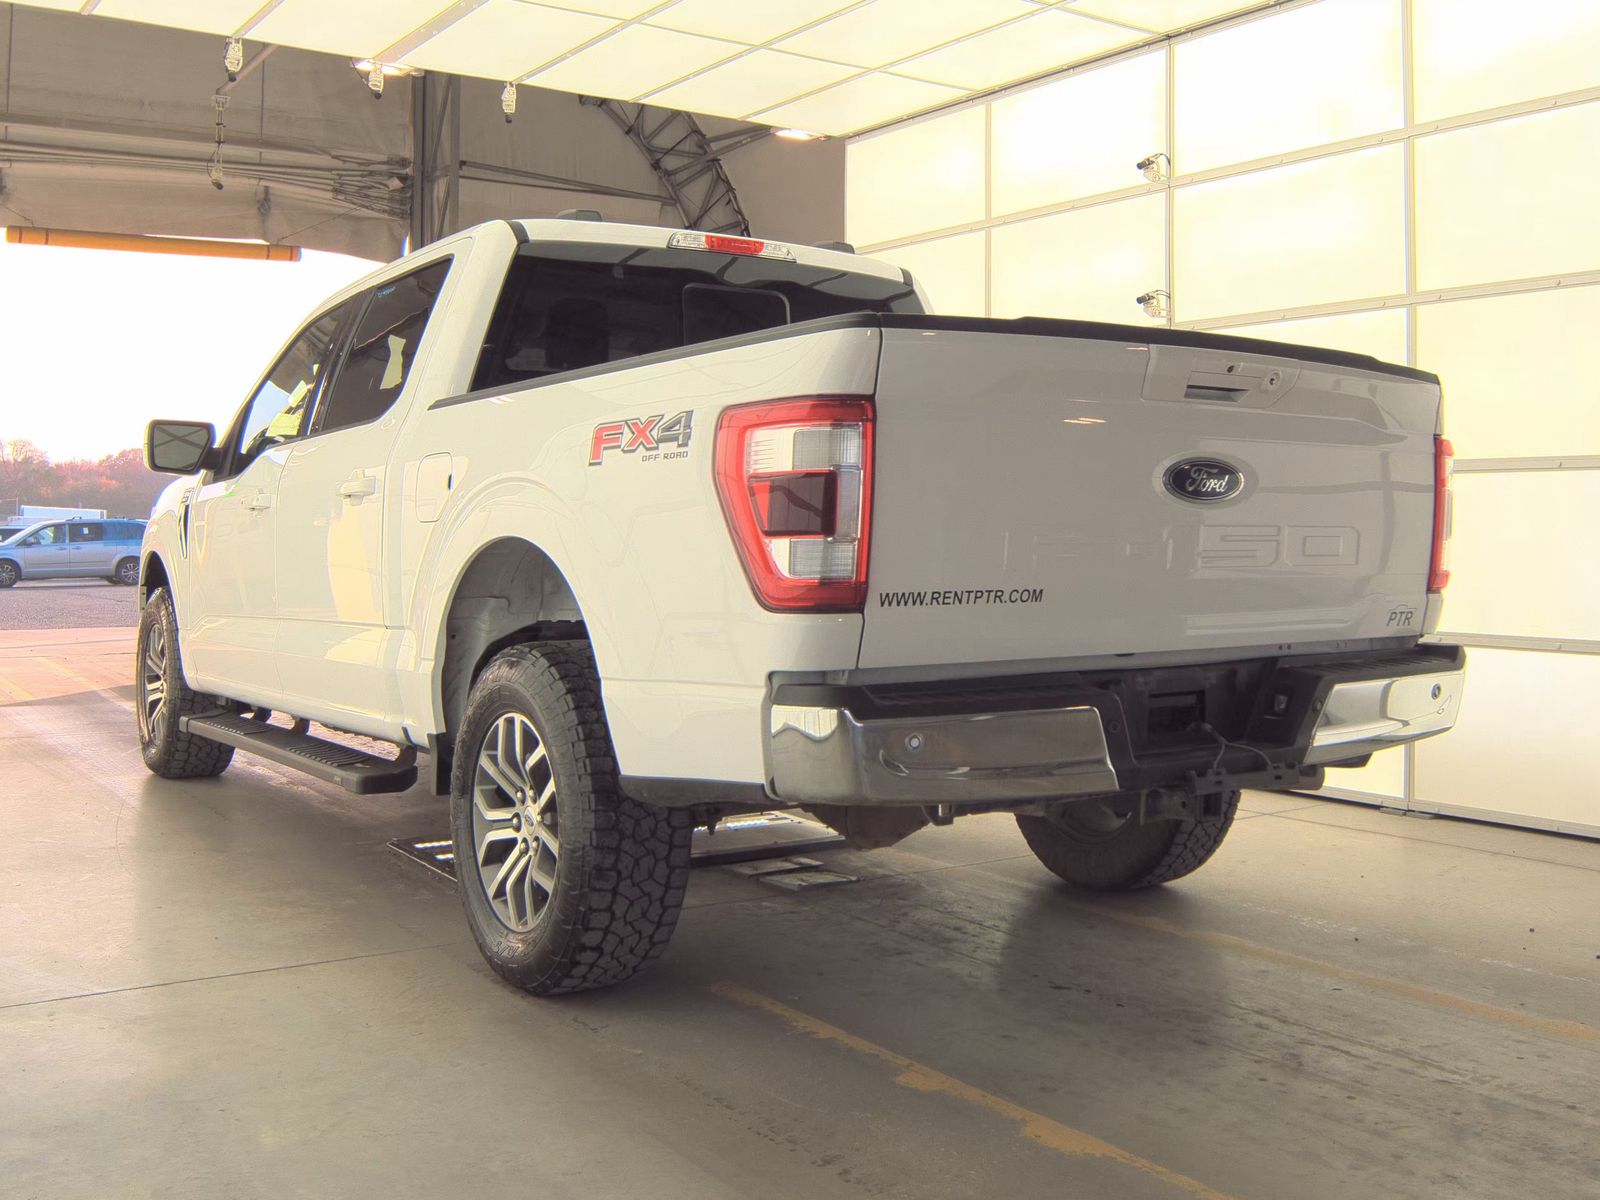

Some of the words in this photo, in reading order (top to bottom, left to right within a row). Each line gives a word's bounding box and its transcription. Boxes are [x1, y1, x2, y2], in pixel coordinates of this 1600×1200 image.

[588, 409, 694, 467] FX4
[641, 453, 661, 462] OFF
[662, 450, 689, 461] ROAD
[1185, 466, 1229, 492] Ford
[879, 588, 1044, 607] WWW.RENTPTR.COM
[1386, 610, 1414, 627] PTR
